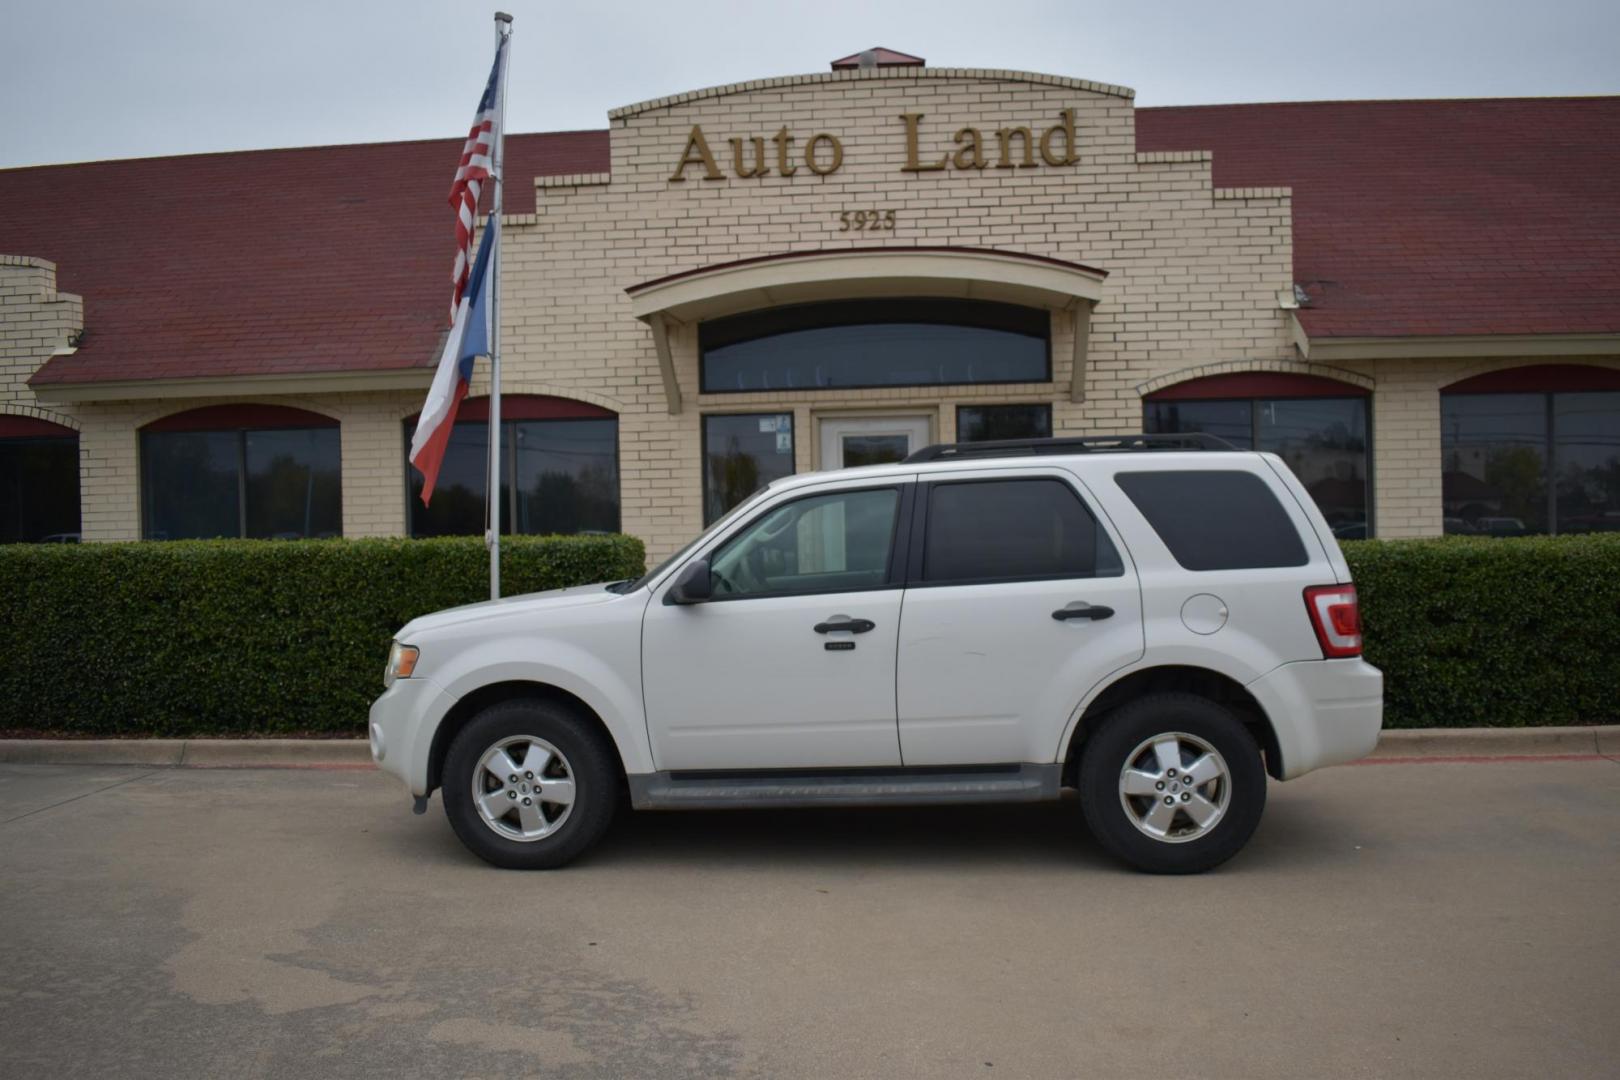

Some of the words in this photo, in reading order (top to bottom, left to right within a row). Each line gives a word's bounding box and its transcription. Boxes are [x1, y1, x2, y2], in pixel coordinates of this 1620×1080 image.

[669, 124, 844, 182] Auto
[899, 108, 1081, 172] Land
[839, 210, 896, 232] 5925
